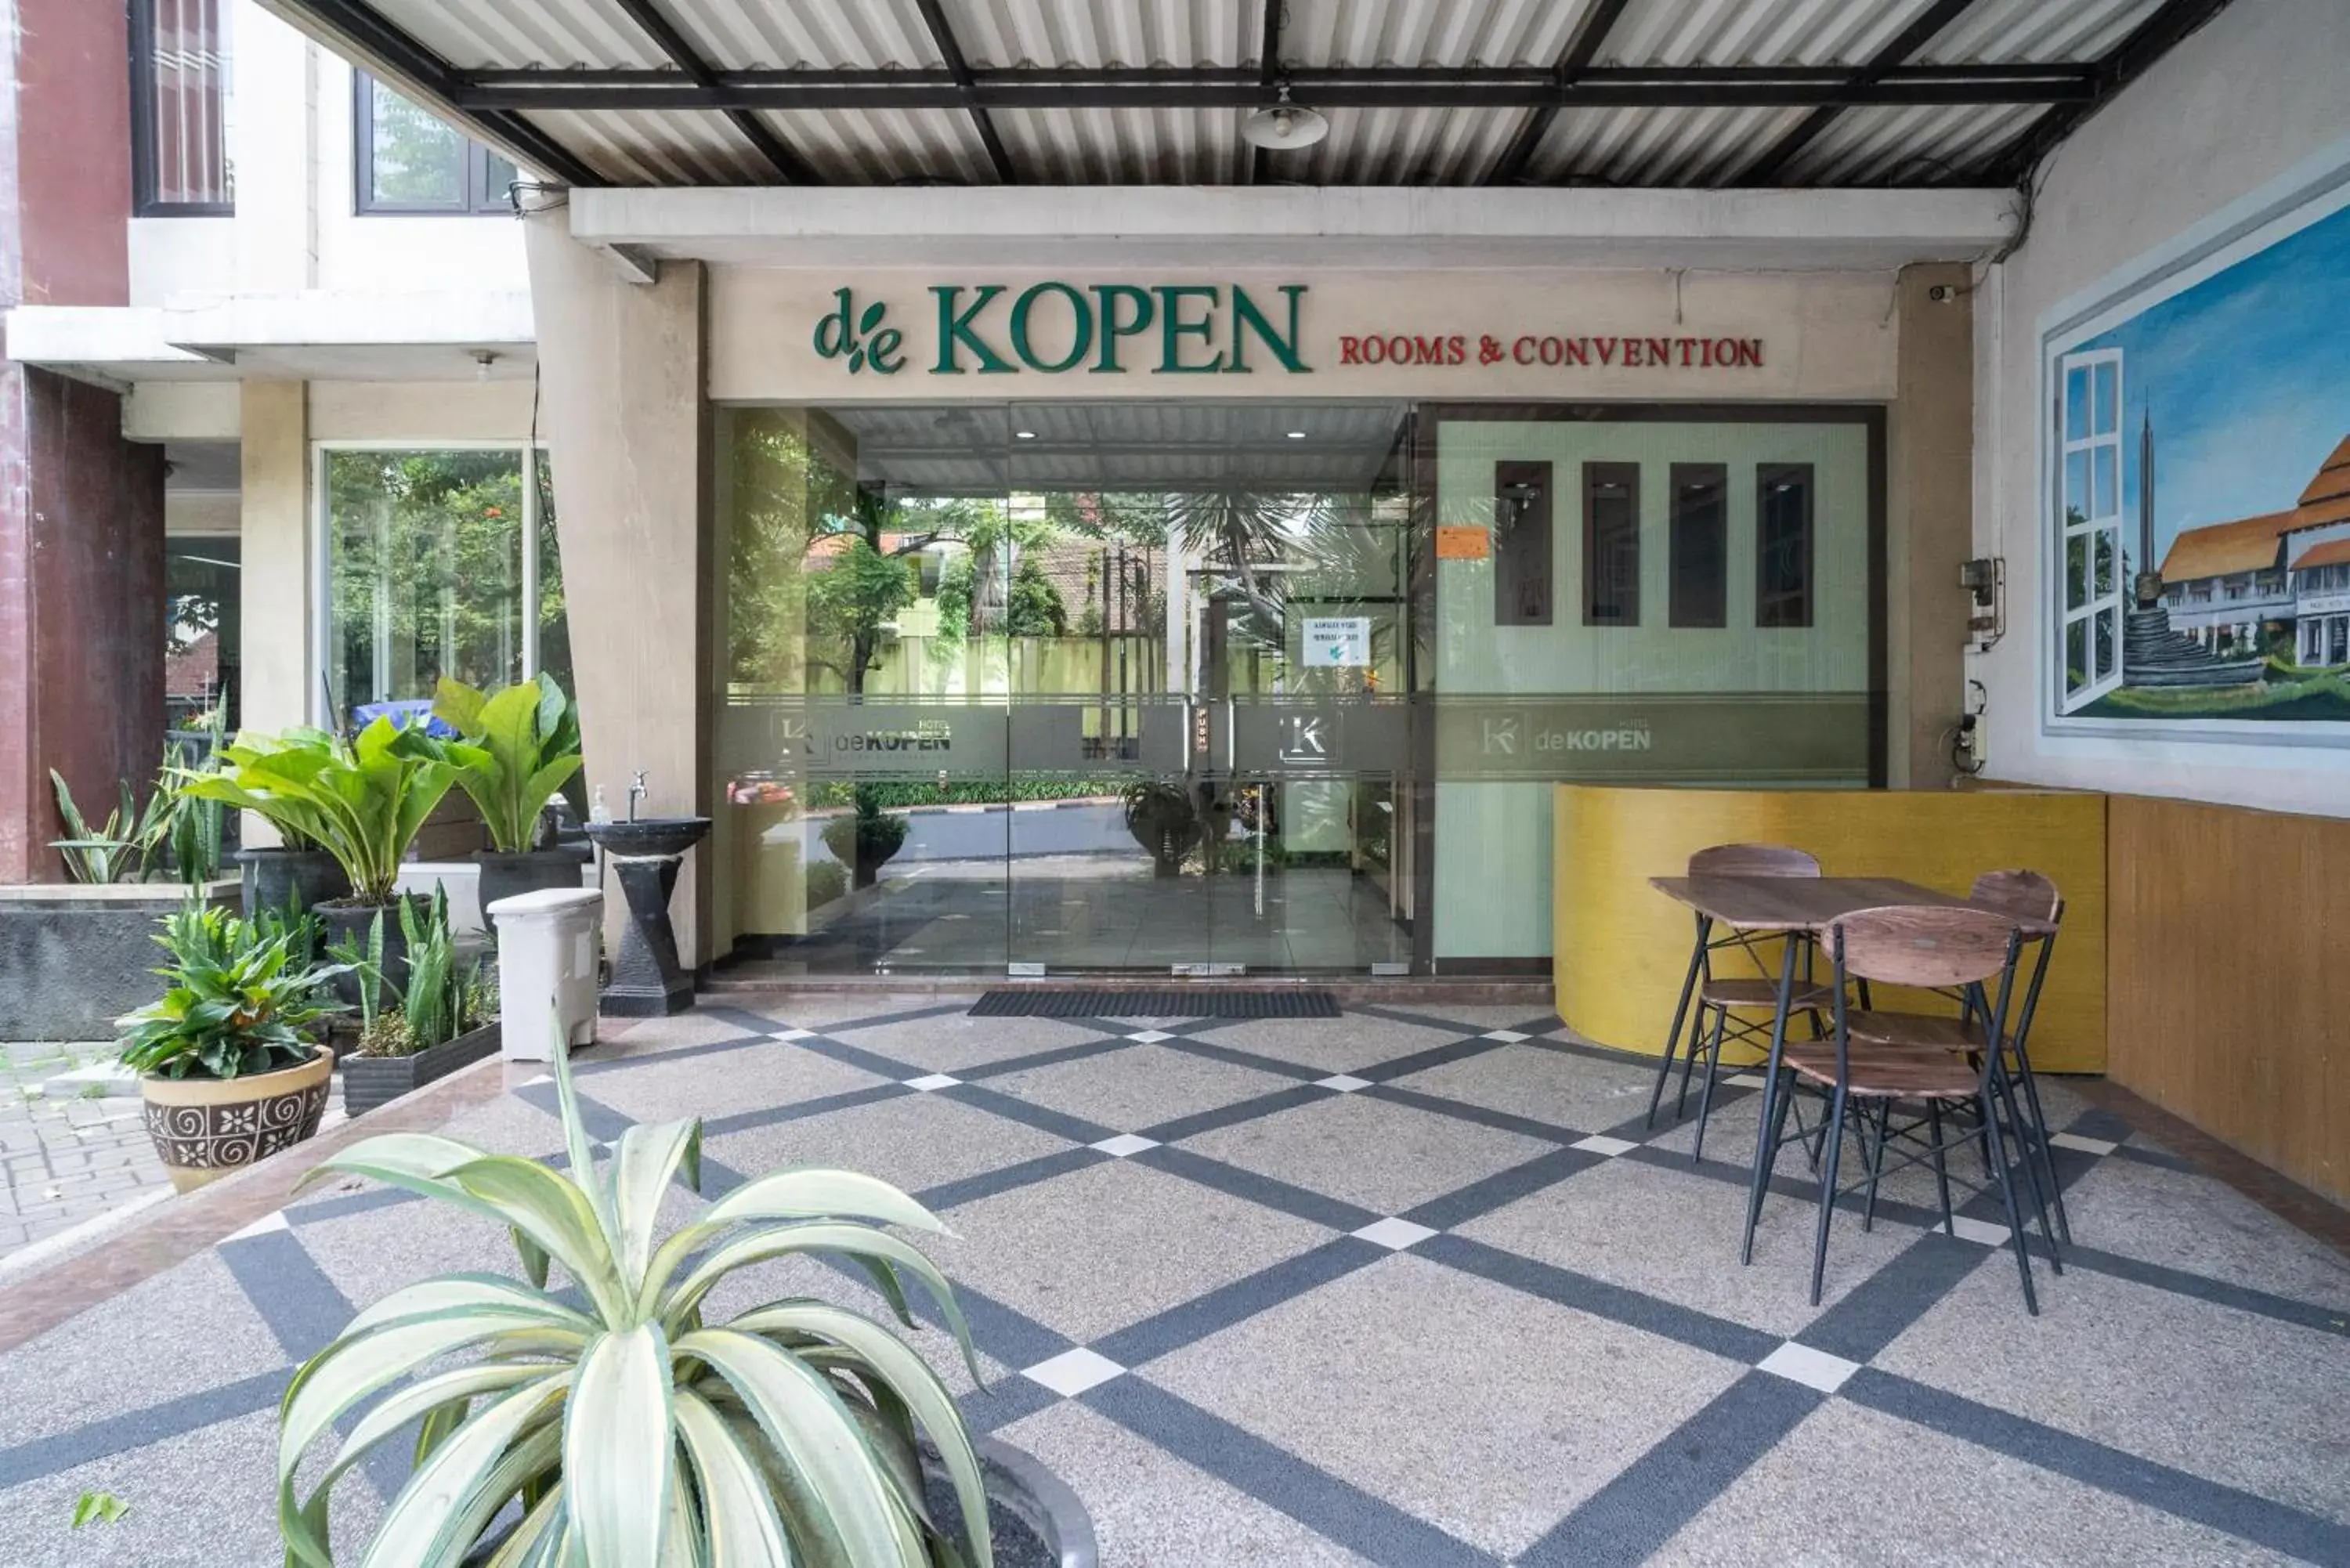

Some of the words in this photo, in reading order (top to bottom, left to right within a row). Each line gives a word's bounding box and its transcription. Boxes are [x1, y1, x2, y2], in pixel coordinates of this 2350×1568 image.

[813, 287, 907, 374] de
[927, 281, 1314, 374] KOPEN
[1339, 335, 1465, 365] ROOMS
[1477, 335, 1507, 367] &
[1513, 336, 1764, 368] CONVENTION
[1535, 728, 1651, 751] deKOPEN
